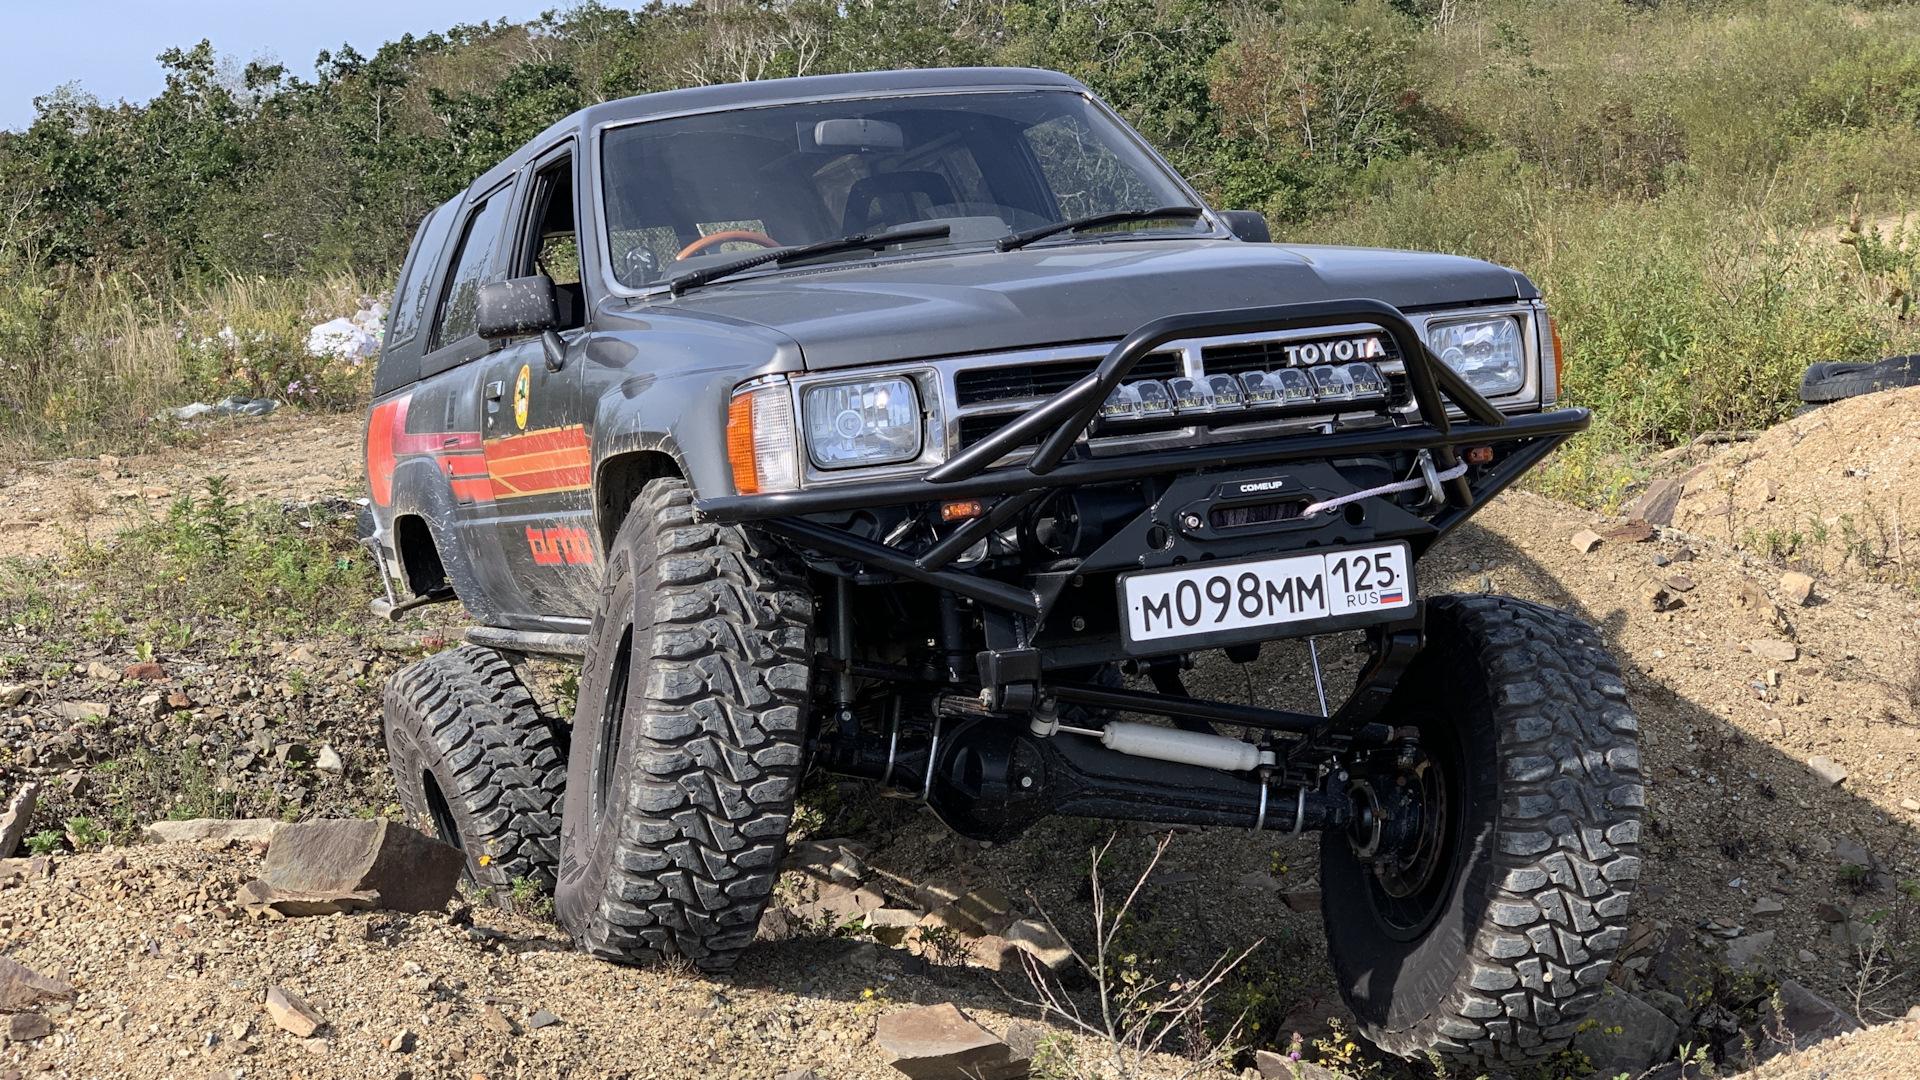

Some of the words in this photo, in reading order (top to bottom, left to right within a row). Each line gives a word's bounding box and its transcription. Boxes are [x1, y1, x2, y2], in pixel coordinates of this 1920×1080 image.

[1284, 337, 1386, 367] TOYOTA
[1240, 481, 1283, 493] COMEUP
[1142, 571, 1325, 632] M098MM
[1331, 552, 1395, 594] 125
[1347, 591, 1379, 607] RUS
